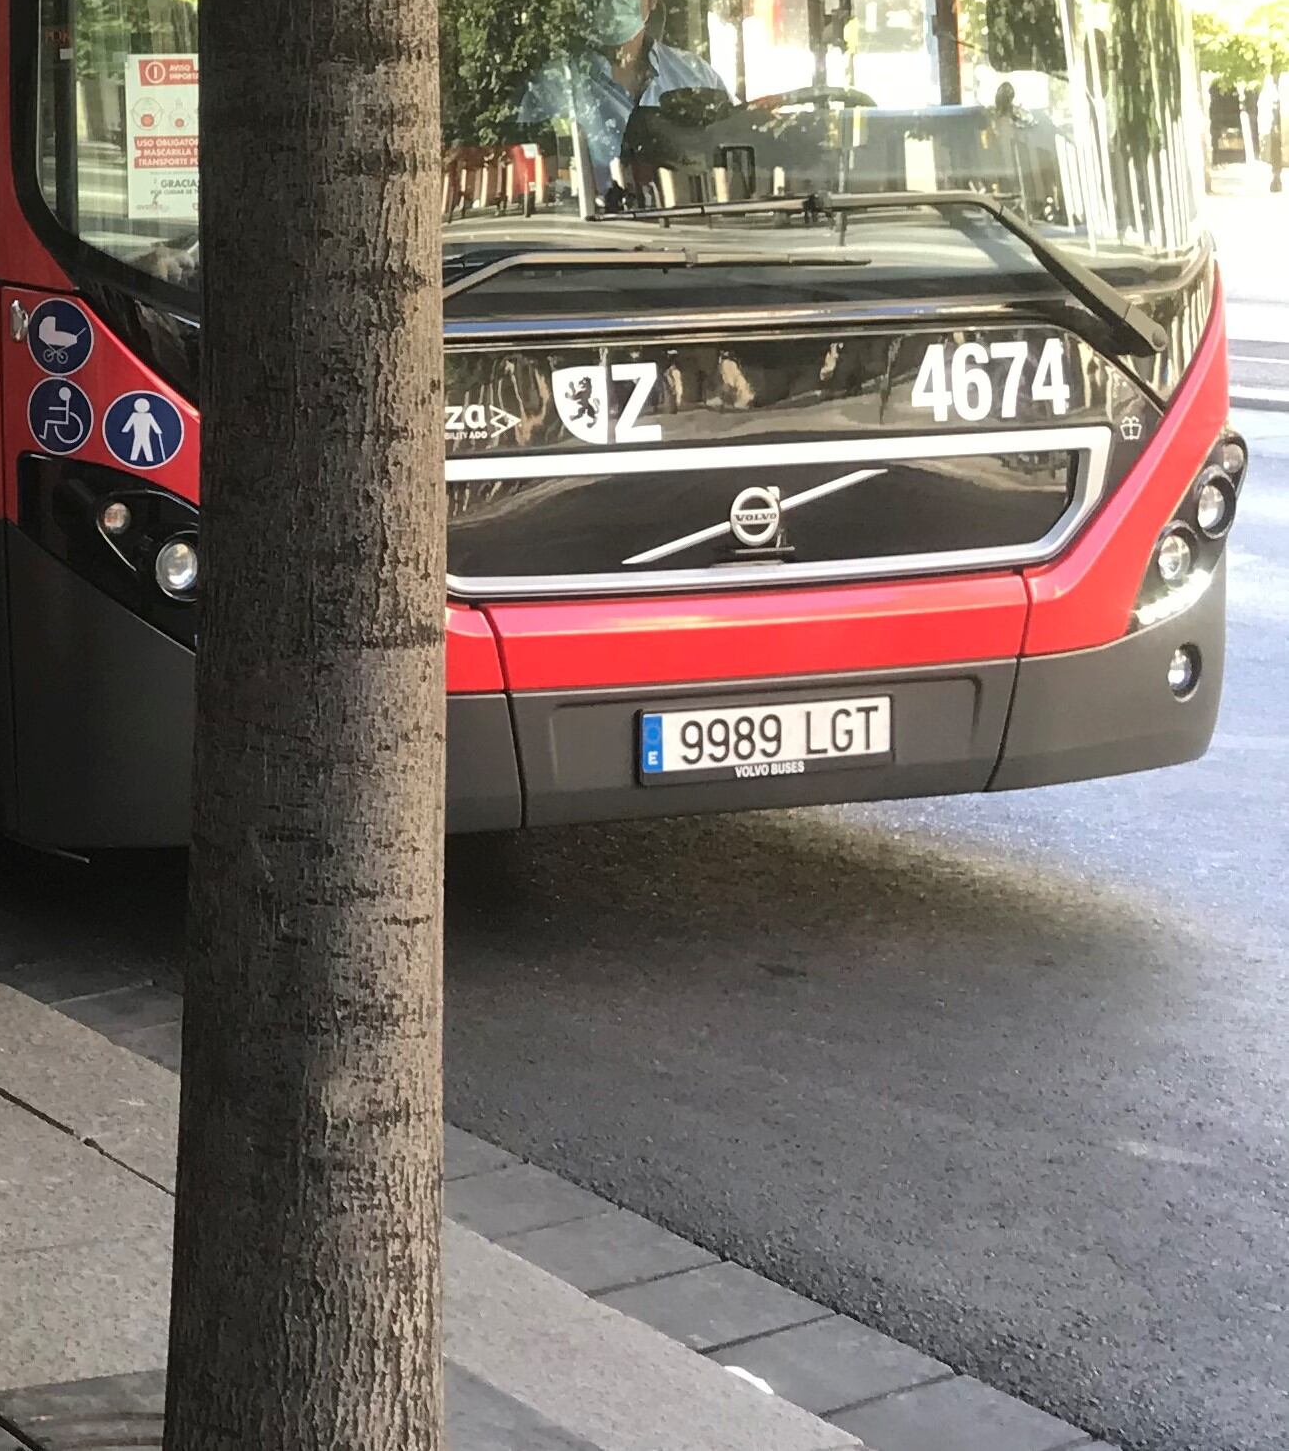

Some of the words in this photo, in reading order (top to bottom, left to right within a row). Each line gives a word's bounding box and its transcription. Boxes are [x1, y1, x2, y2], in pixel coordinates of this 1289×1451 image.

[137, 139, 154, 147] USO
[143, 148, 192, 157] MASCARILLA
[138, 158, 188, 167] TRANSPORTE
[160, 178, 198, 188] GRACIA
[912, 339, 1071, 423] 4674
[444, 404, 487, 430] za
[733, 512, 777, 522] VOLVO
[647, 750, 659, 766] E
[680, 713, 783, 766] 9989
[804, 705, 879, 755] LGT
[734, 764, 770, 778] VOLVO
[771, 760, 805, 776] BUSES
